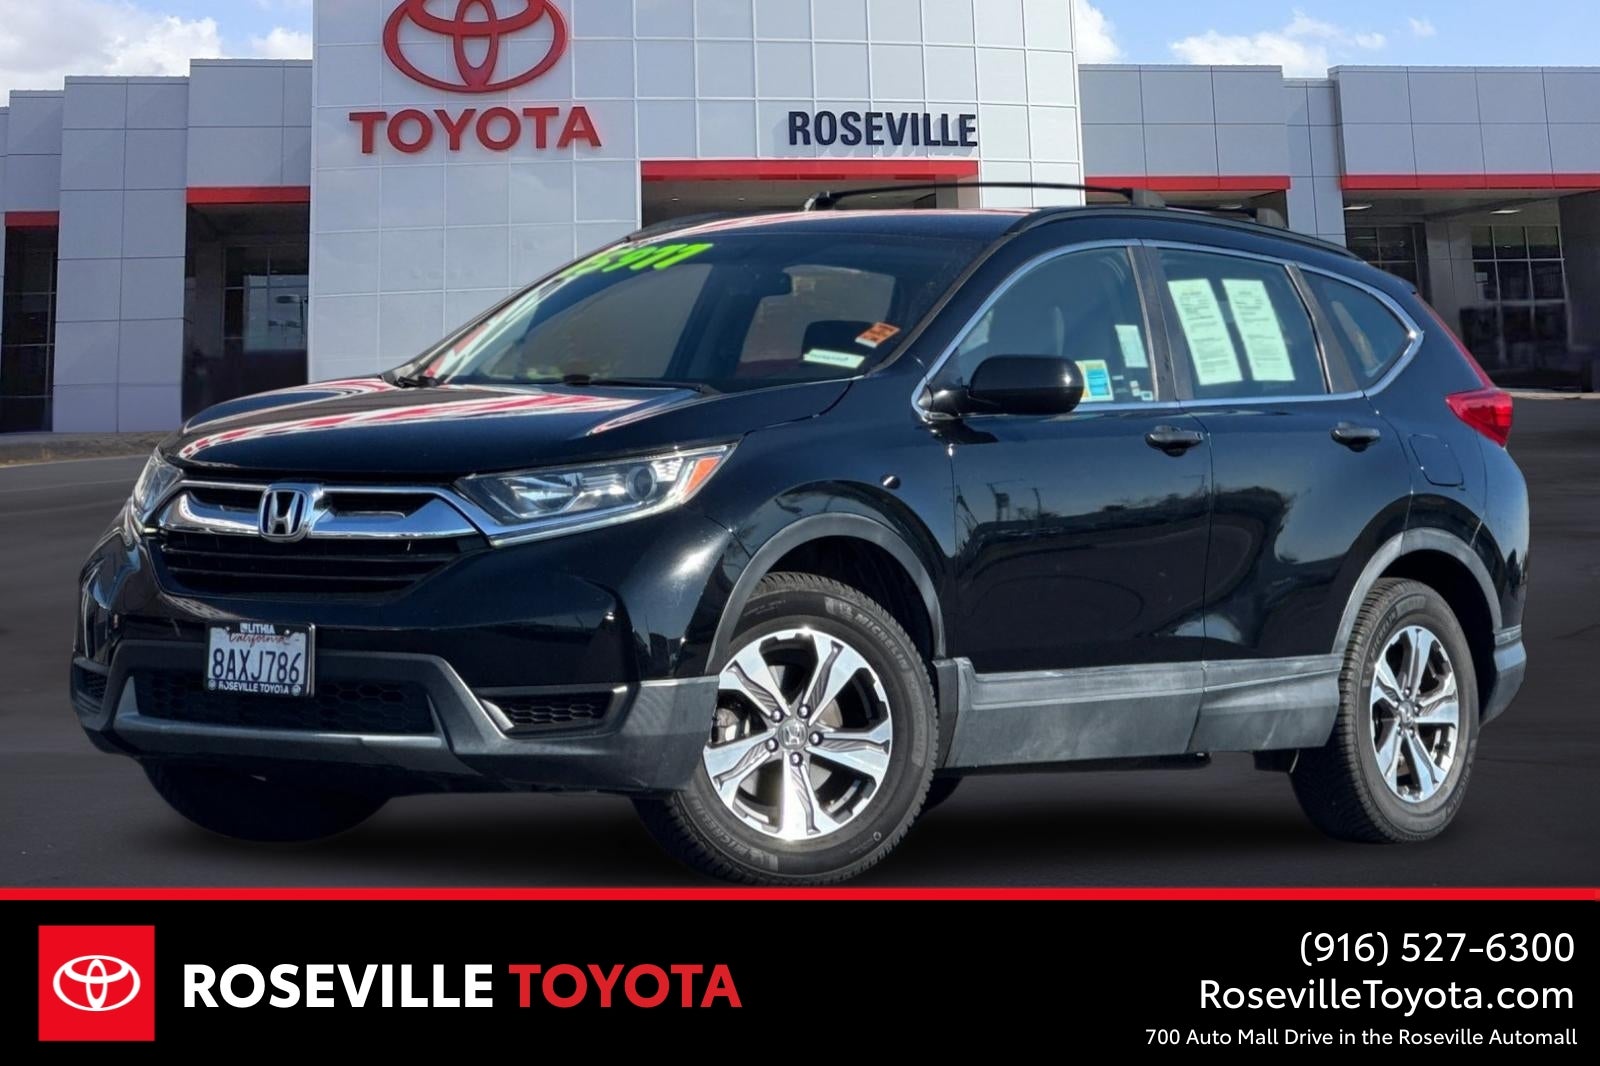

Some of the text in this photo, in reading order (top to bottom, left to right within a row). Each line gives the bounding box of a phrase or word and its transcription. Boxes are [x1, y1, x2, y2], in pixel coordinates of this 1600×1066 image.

[349, 106, 602, 154] TOYOTA
[788, 110, 979, 148] ROSEVILLE
[211, 647, 302, 683] 8AXJ786
[218, 681, 289, 694] ROSEVILLE TOYOTA
